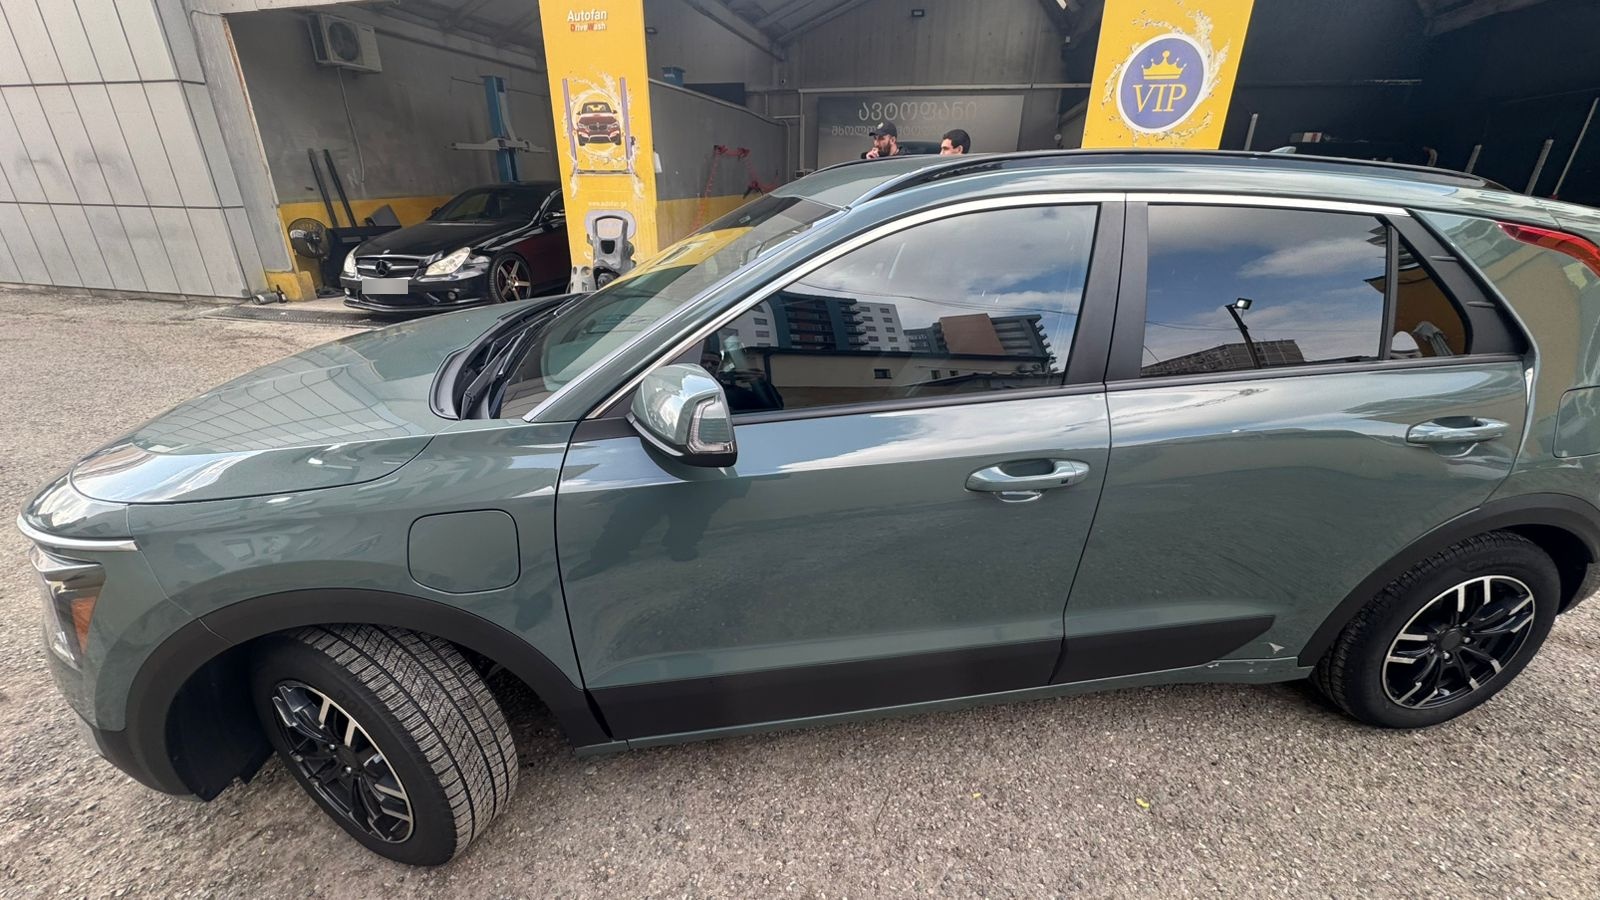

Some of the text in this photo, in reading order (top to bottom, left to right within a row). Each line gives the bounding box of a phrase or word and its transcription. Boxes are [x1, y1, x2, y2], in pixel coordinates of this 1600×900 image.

[567, 9, 607, 22] Autofan
[1132, 83, 1188, 113] VIP
[858, 101, 977, 121] ავტოფანი
[831, 125, 878, 137] მხოლო
